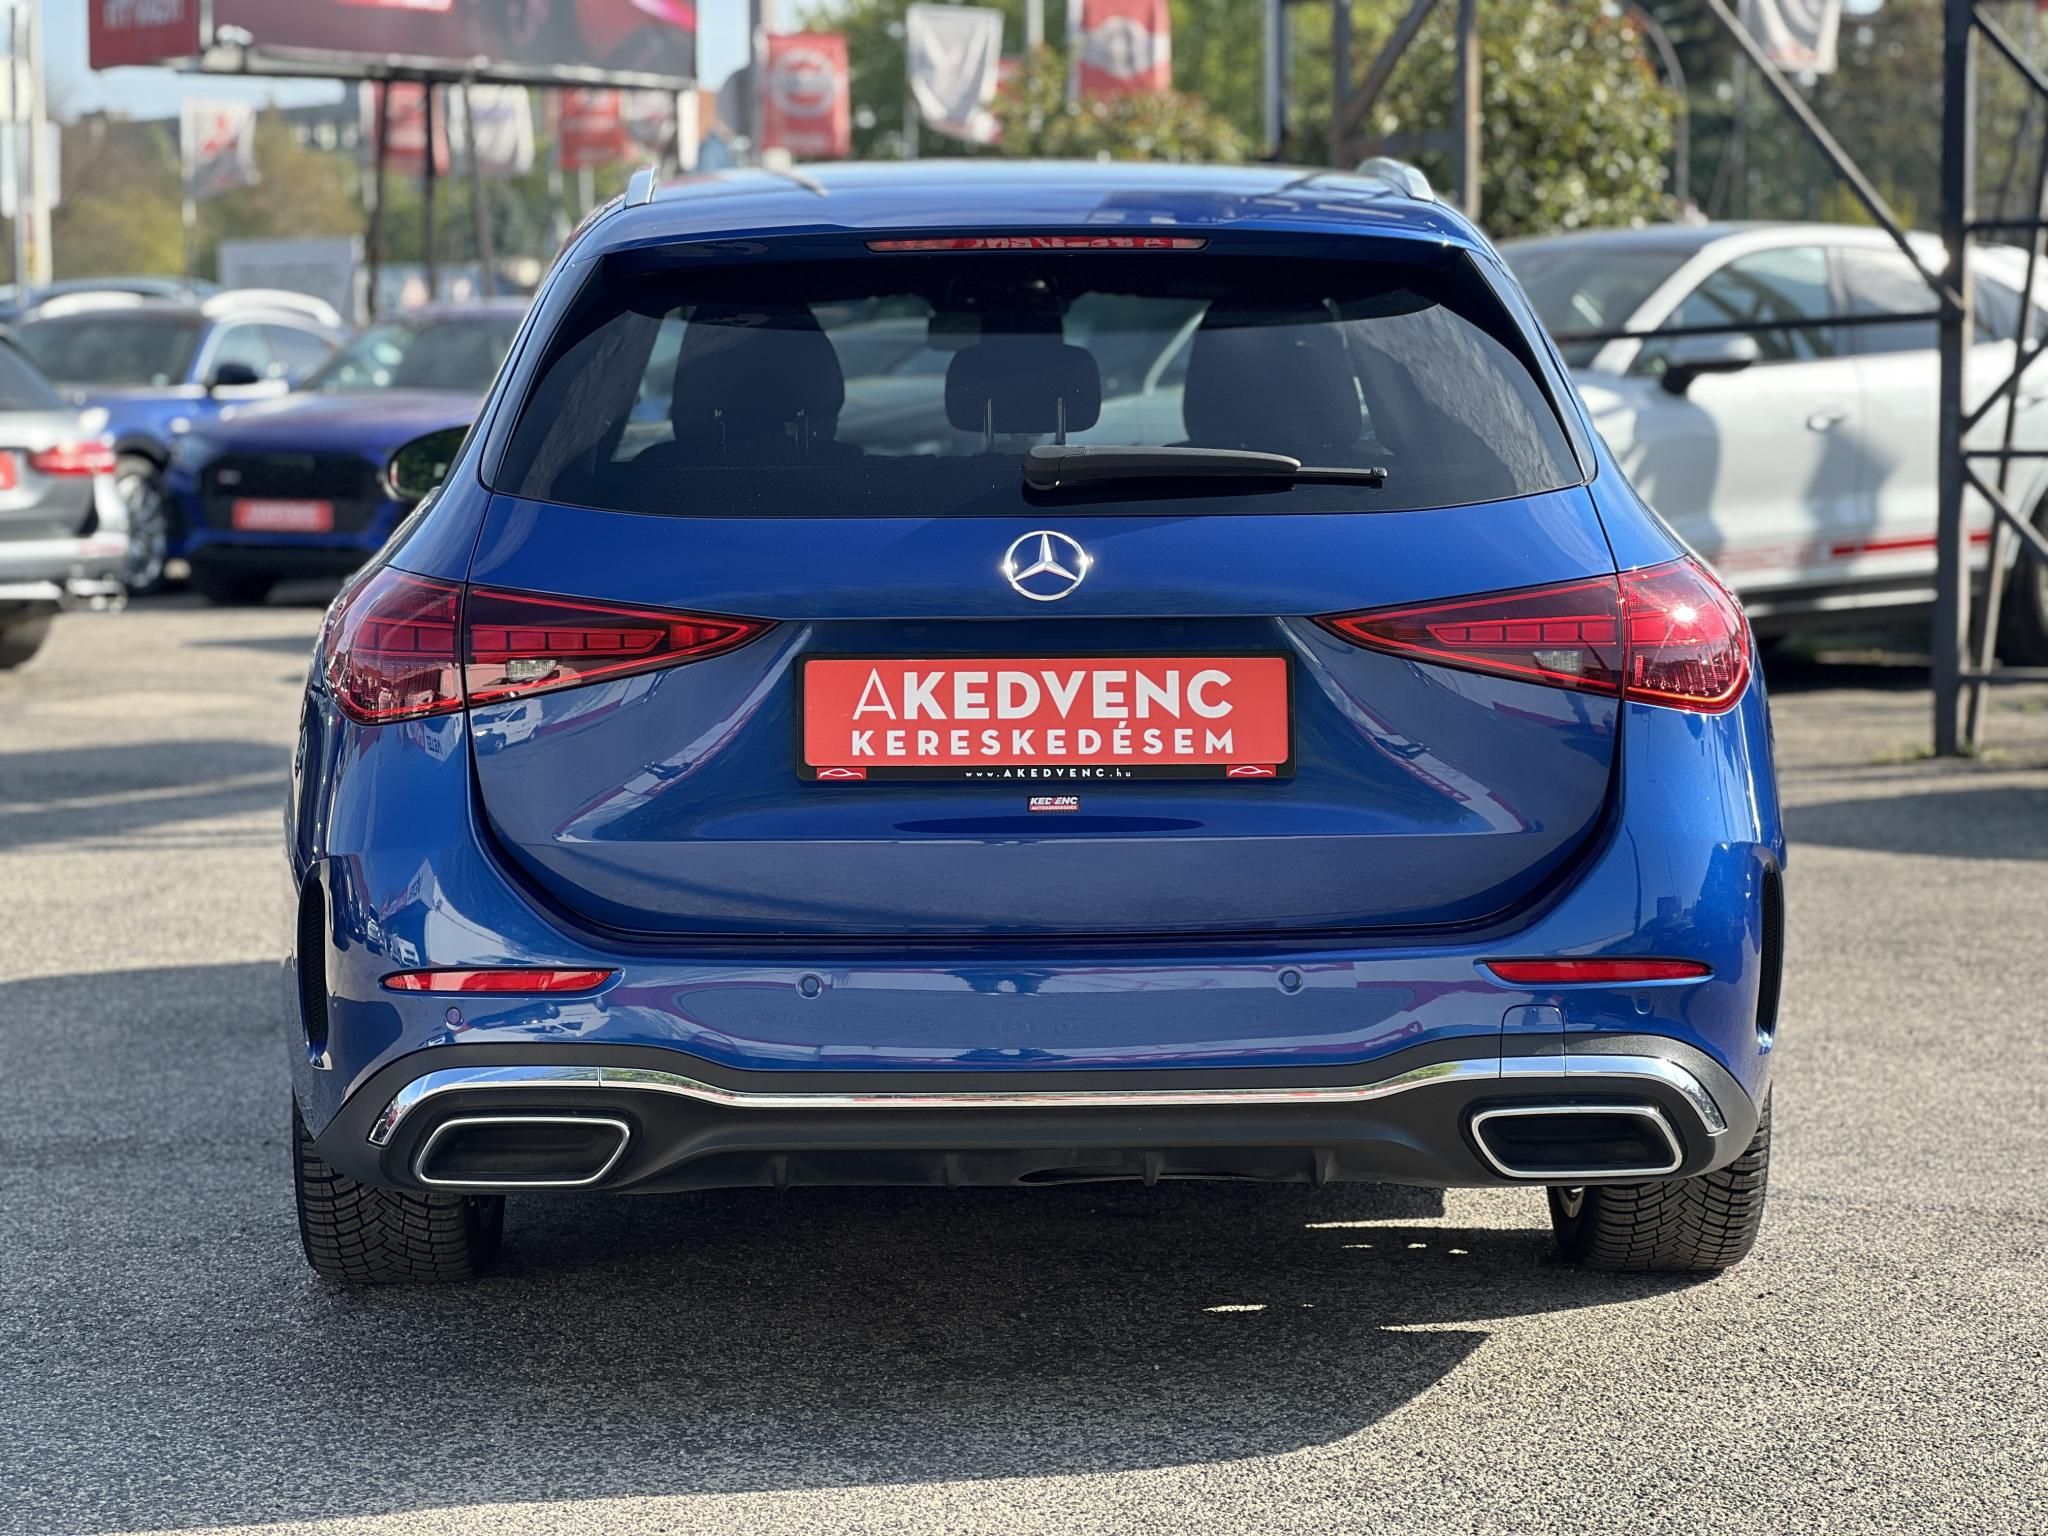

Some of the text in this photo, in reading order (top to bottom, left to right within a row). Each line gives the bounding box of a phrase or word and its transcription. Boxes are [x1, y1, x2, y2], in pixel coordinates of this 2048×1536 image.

[852, 668, 1233, 720] AKEDVENC
[852, 720, 1233, 756] KERESKEDÉSEM
[965, 767, 1132, 778] www.AKEDVENC.hu
